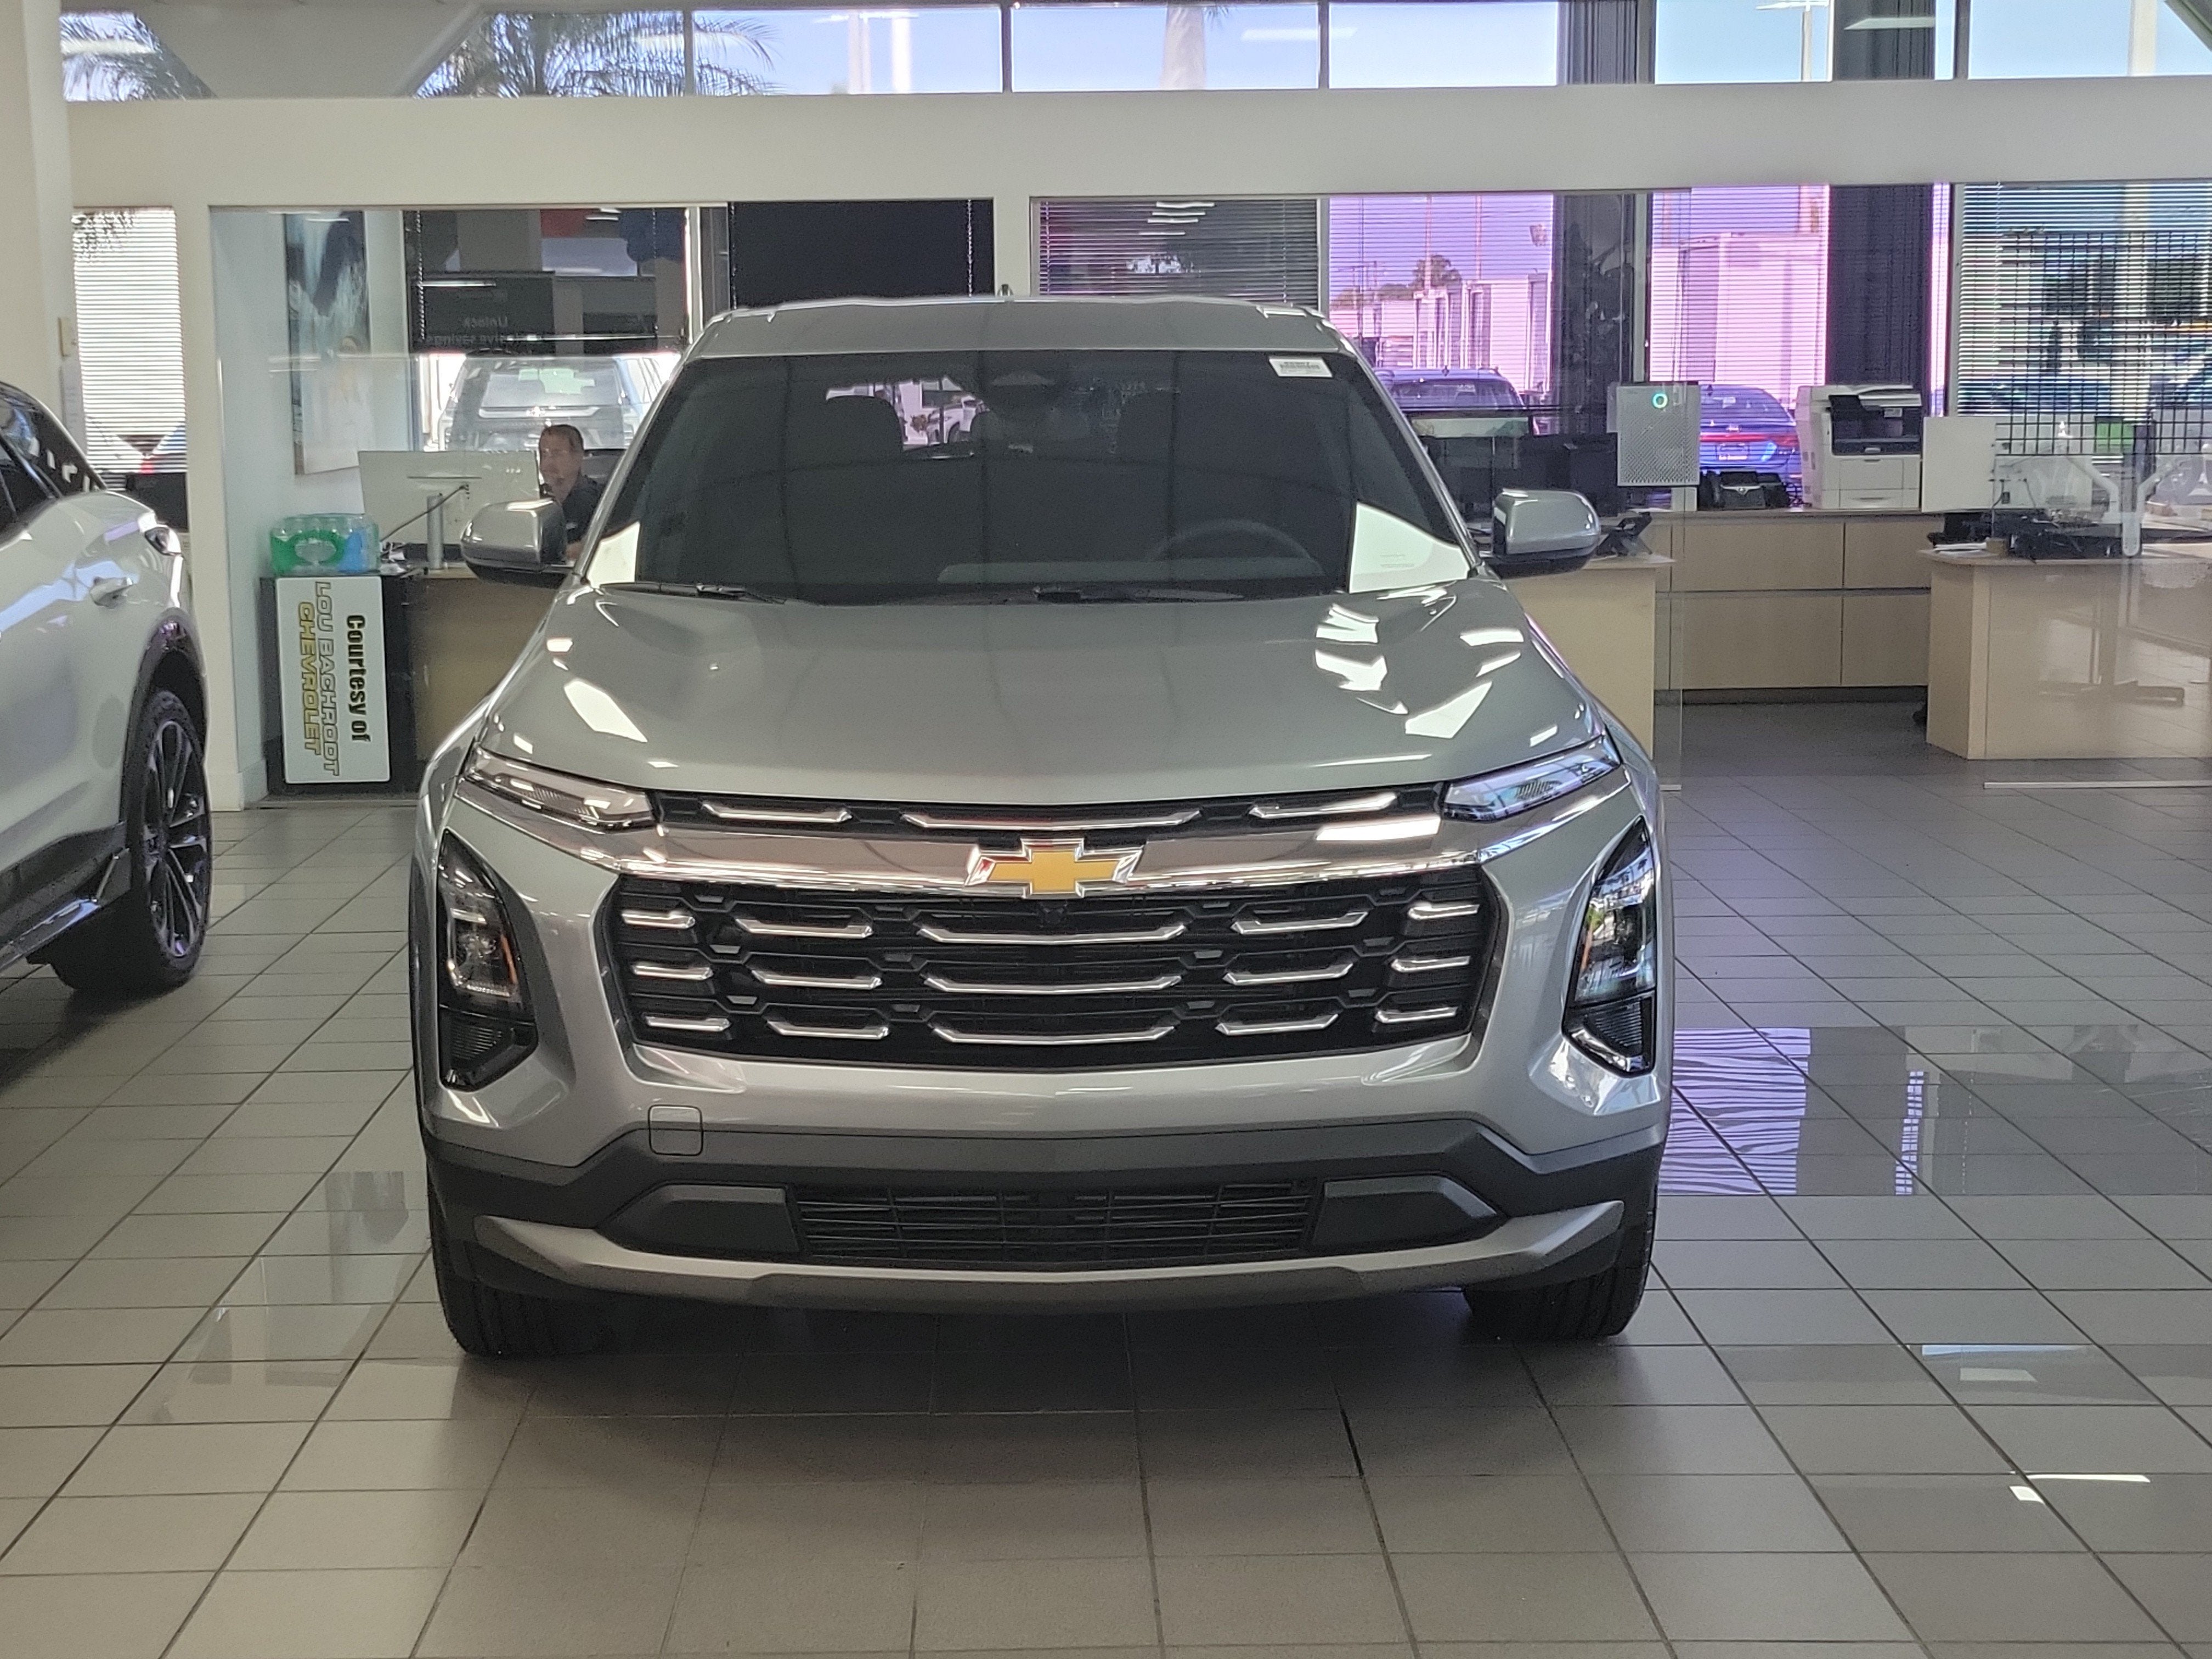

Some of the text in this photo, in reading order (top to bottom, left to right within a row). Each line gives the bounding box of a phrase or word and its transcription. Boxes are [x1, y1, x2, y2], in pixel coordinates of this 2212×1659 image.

[298, 602, 321, 756] CHEVROLET
[315, 581, 340, 776] LOU BACHRODT
[346, 615, 371, 743] Courtesy of
